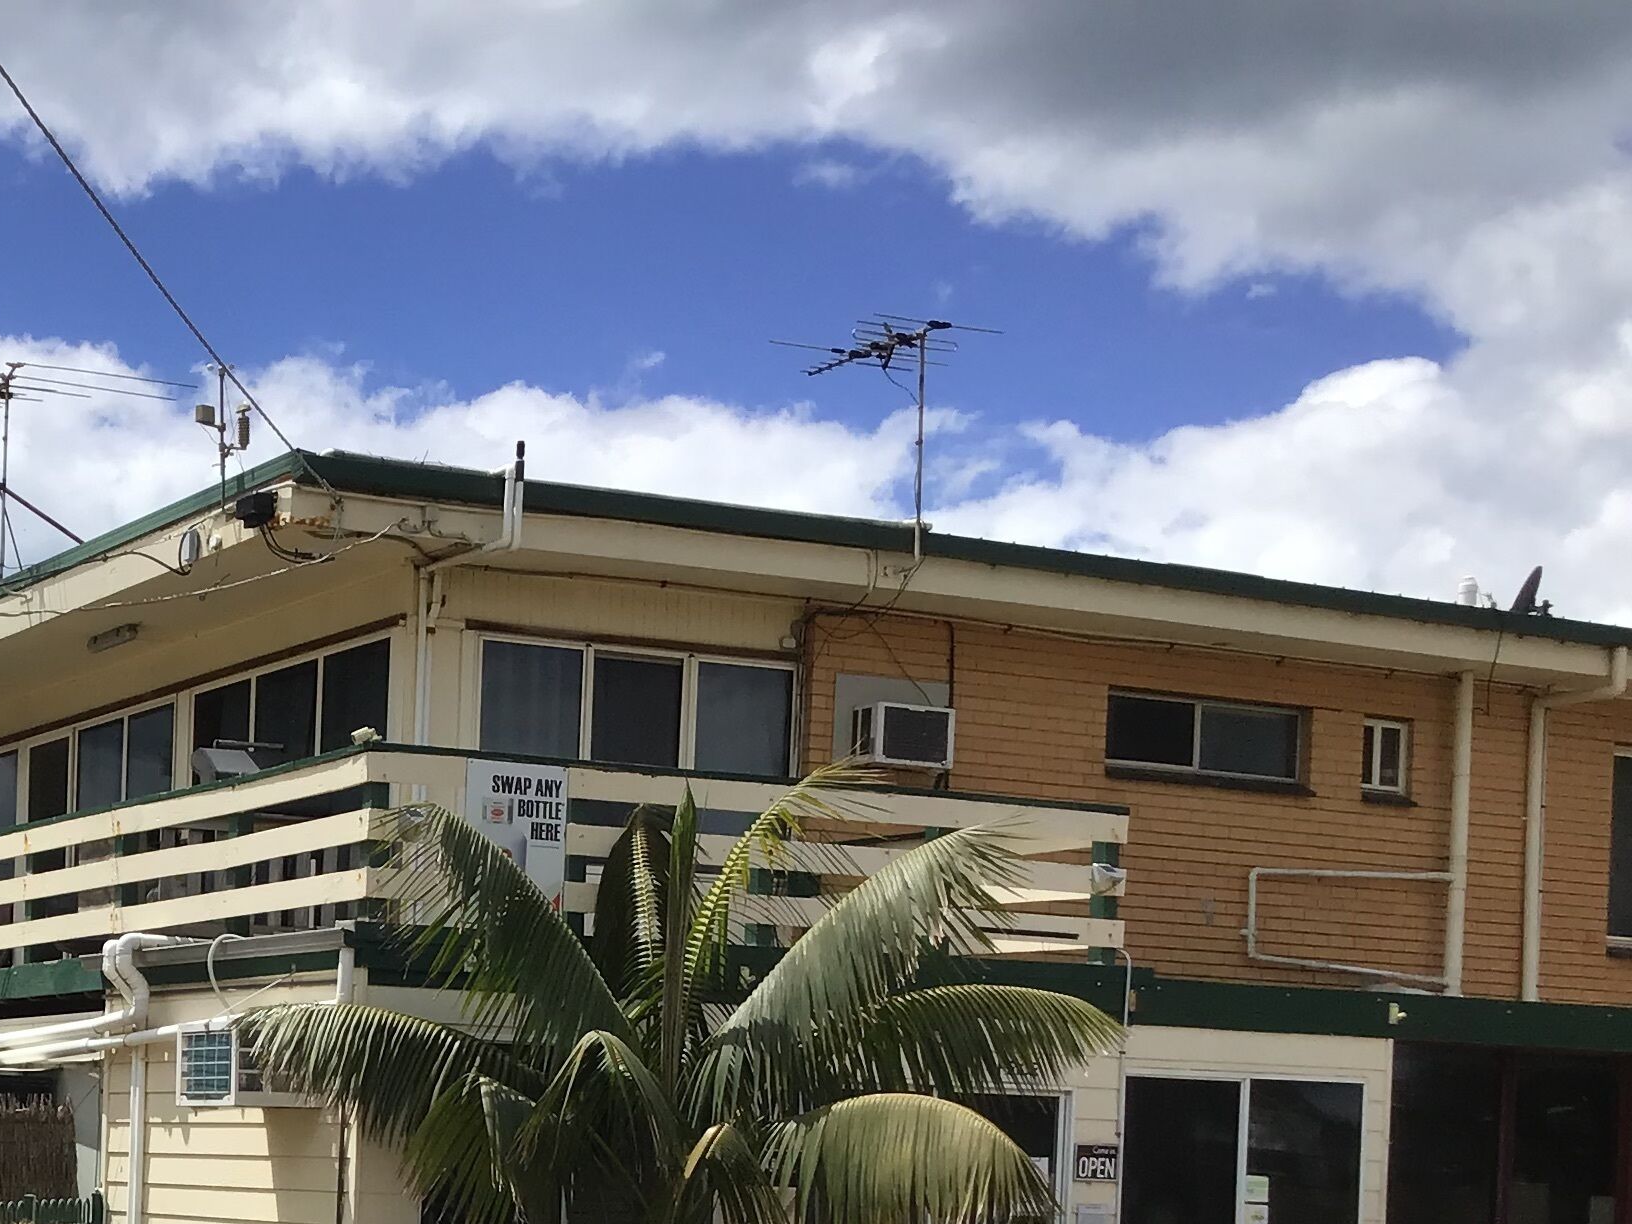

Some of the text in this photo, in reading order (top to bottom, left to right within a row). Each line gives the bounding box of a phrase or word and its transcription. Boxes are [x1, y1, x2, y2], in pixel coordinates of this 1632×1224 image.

[492, 775, 562, 798] SWAP ANY
[518, 799, 562, 820] BOTTLE
[531, 822, 560, 842] HERE
[1078, 1157, 1115, 1178] OPEN
